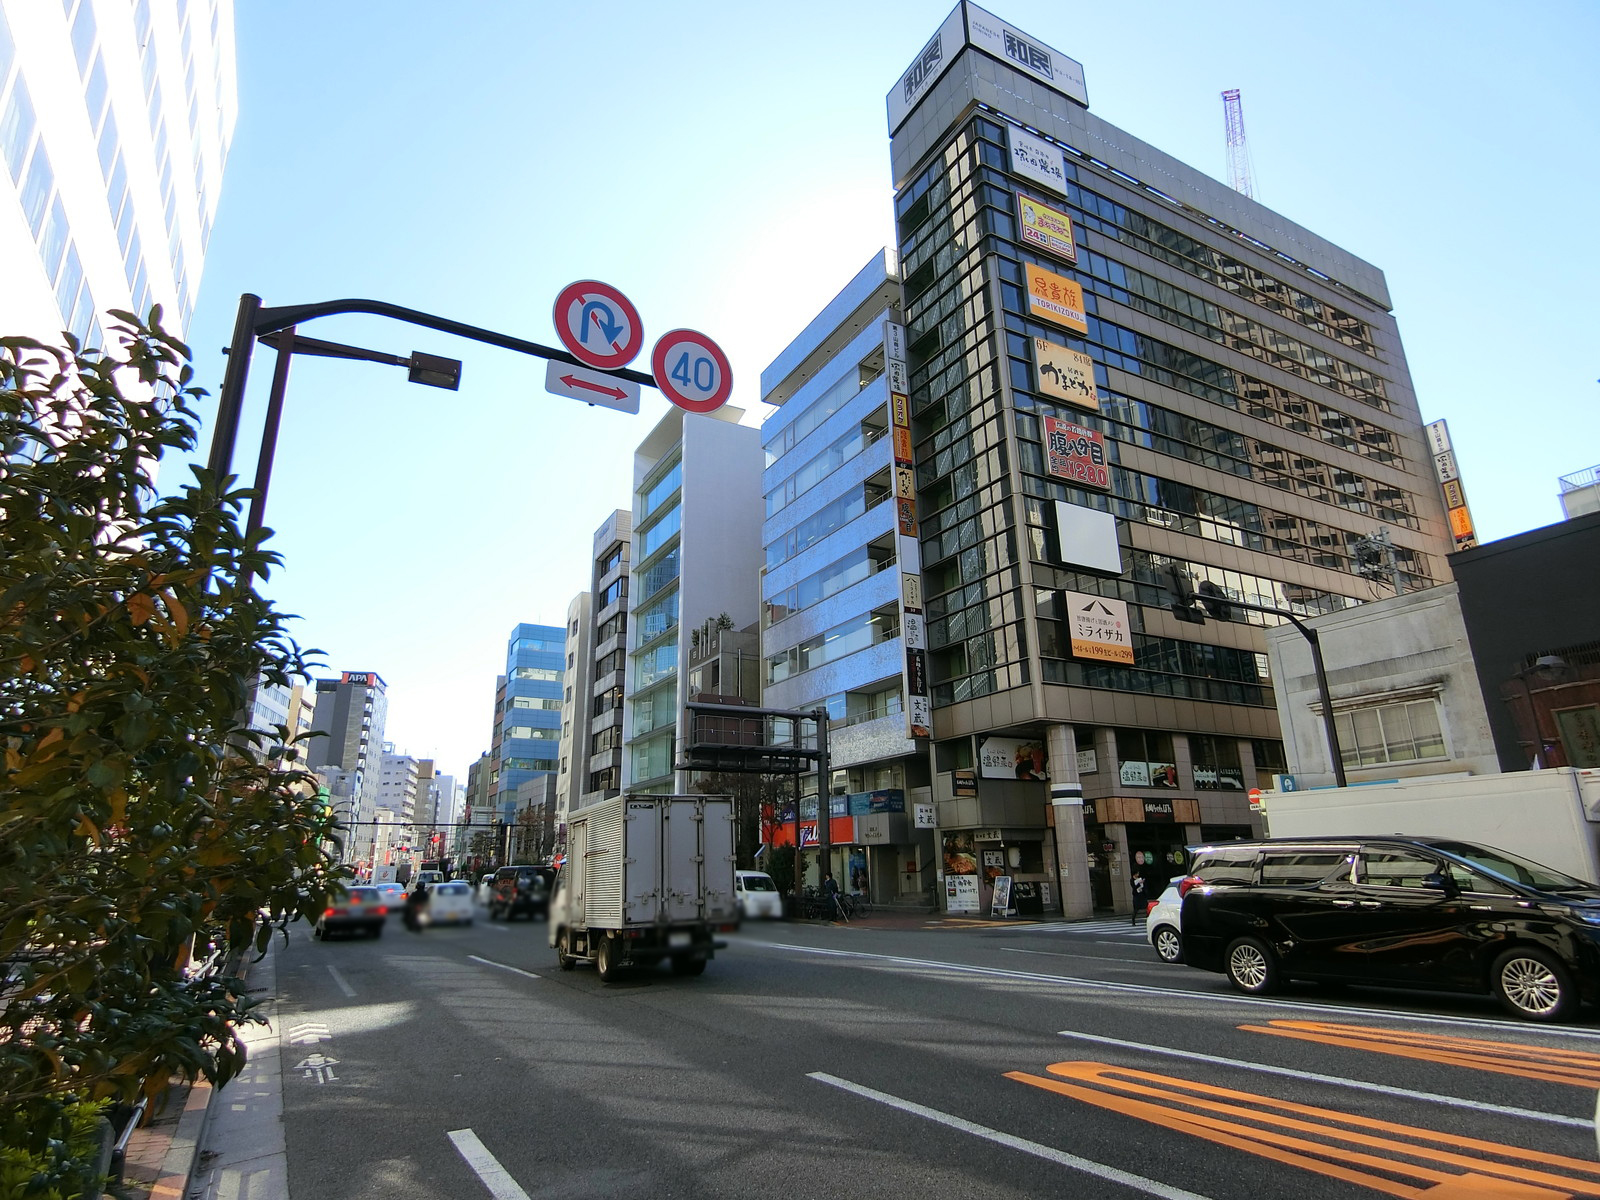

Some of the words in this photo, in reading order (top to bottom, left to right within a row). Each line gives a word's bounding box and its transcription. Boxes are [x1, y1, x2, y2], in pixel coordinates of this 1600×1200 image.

[905, 38, 940, 96] 和民
[1005, 33, 1052, 77] 和民
[1035, 297, 1080, 321] TORIKIZOKU
[1036, 339, 1048, 352] 6F
[671, 351, 714, 392] 40
[1049, 430, 1105, 467] 腹八分目
[1078, 623, 1123, 642] ミライザカ
[348, 674, 368, 682] APA
[913, 699, 925, 725] 文蔵
